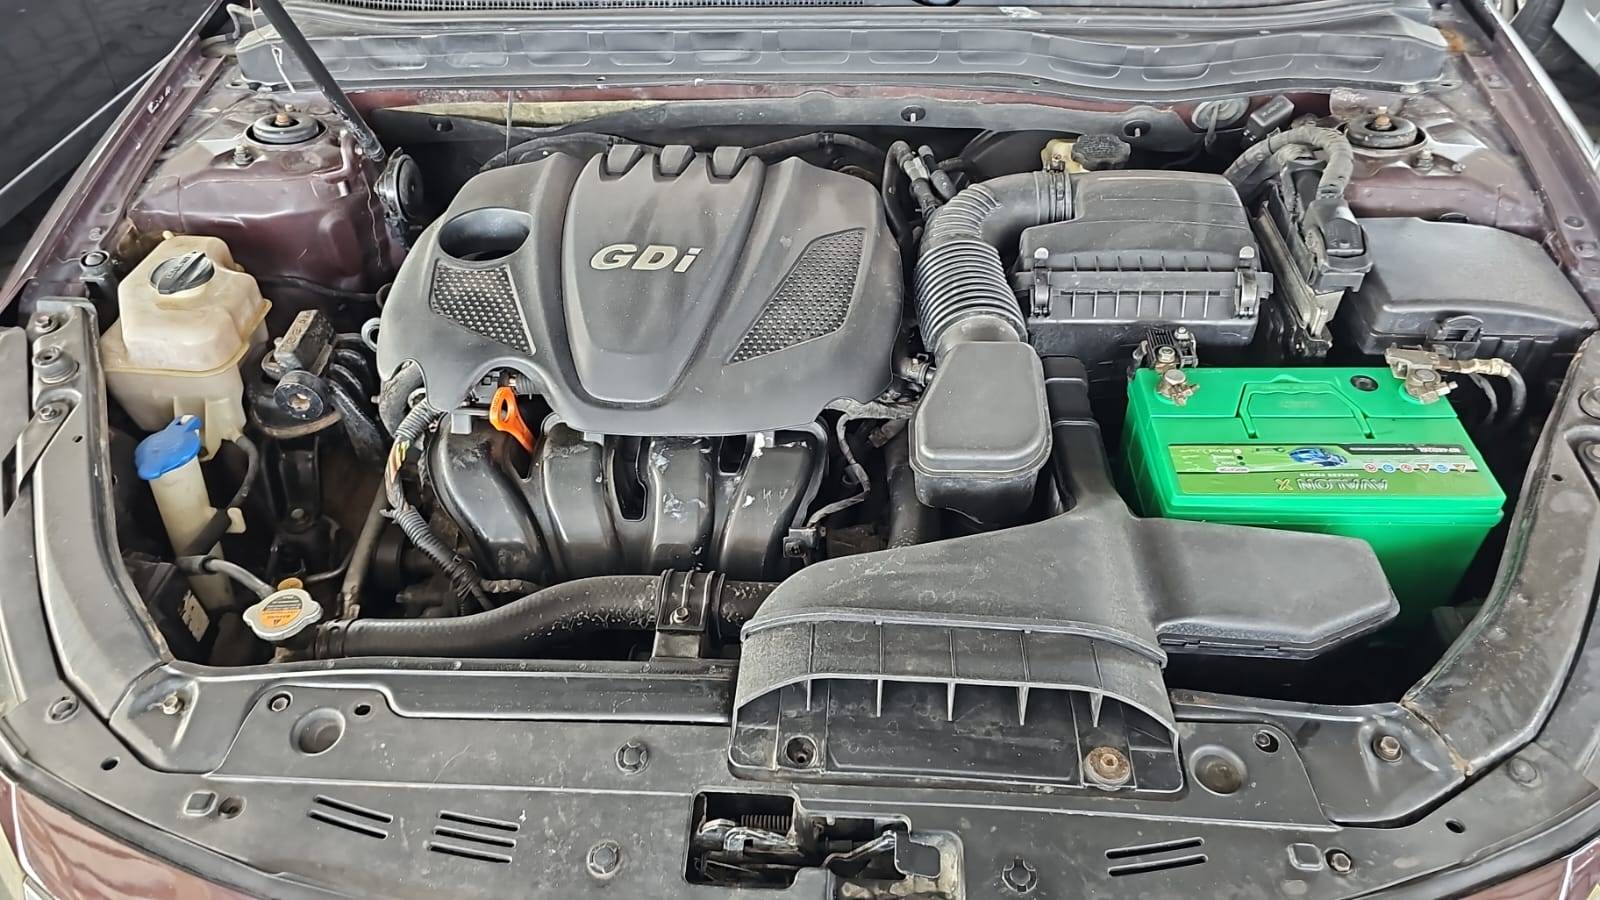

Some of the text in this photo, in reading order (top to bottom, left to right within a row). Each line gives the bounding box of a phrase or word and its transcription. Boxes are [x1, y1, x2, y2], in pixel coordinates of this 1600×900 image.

[591, 244, 704, 274] GDi
[1276, 479, 1388, 491] AVALON X
